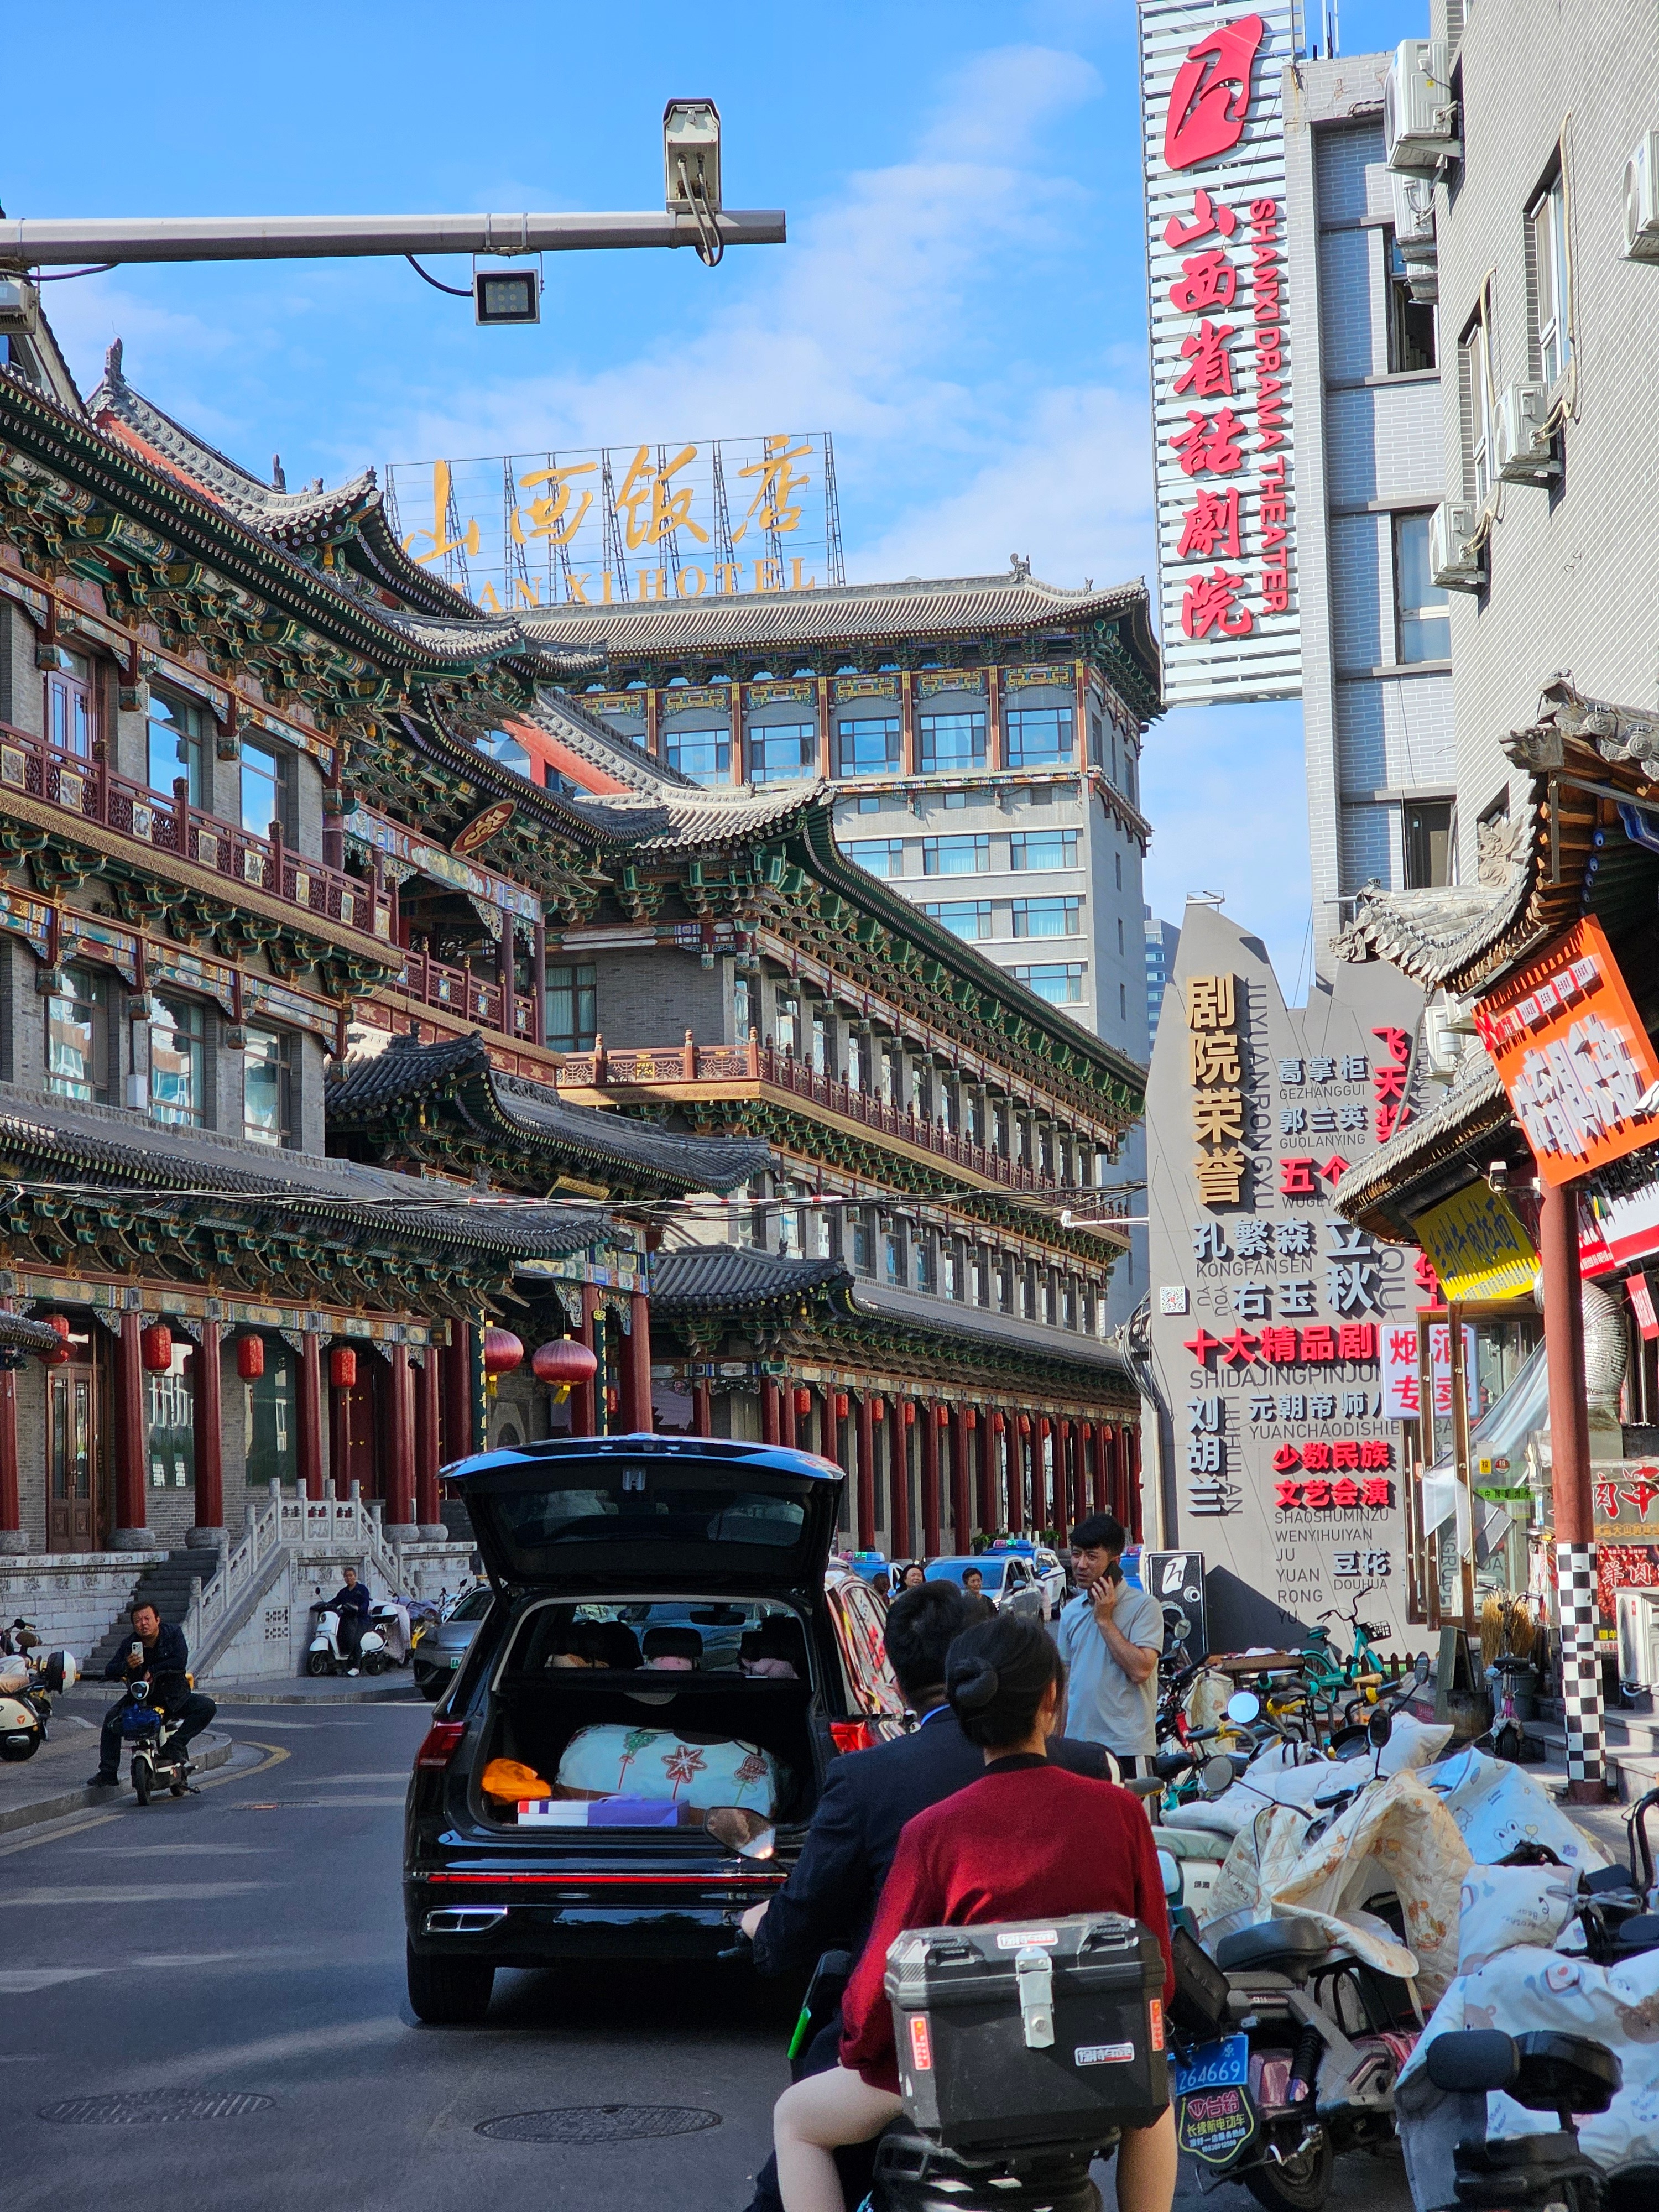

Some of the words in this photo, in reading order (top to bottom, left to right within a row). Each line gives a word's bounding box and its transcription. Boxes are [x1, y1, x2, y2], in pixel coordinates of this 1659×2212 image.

[1249, 199, 1281, 321] SHANXI
[1254, 326, 1284, 451] DRAMA
[1163, 189, 1254, 638] 山西省話劇院
[401, 434, 814, 564] 山西饭店
[1258, 454, 1288, 614] THEATER
[451, 577, 543, 613] AN
[635, 557, 816, 602] HOTEL
[1278, 1055, 1369, 1083] 葛掌柜
[1371, 1026, 1408, 1143] 飞天奖
[1185, 972, 1246, 1204] 剧院荣誉
[1245, 978, 1274, 1209] JUYUANRONGYU
[1279, 1084, 1366, 1100] GEZHANGGUI
[1279, 1104, 1366, 1133] 郭兰英
[1279, 1134, 1366, 1150] GUOLANYING
[1282, 1194, 1335, 1209] WUGEY
[1192, 1217, 1313, 1259] 孔繁森
[1196, 1258, 1313, 1277] KONGFANSEN
[1323, 1217, 1375, 1312] 立秋
[1197, 1286, 1210, 1306] YU
[1214, 1285, 1228, 1317] YOU
[1233, 1278, 1314, 1317] 右玉
[1184, 1322, 1381, 1365] 十大精品剧
[1389, 1329, 1468, 1366] 烟酒
[1391, 1375, 1470, 1412] 专卖
[1186, 1395, 1223, 1514] 刘胡兰
[1223, 1396, 1244, 1515] LIUHULAN
[1272, 1440, 1389, 1470] 少数民族
[1273, 1478, 1389, 1508] 文艺会演
[1274, 1507, 1389, 1525] SHAOSHUMINZU
[1275, 1528, 1373, 1543] WENYIHUIYAN
[1275, 1548, 1295, 1562] JU
[1333, 1548, 1389, 1575] 豆花
[1276, 1568, 1321, 1583] YUAN
[1333, 1578, 1389, 1592] DOUHUA
[1278, 1589, 1323, 1603] RONG
[1279, 1611, 1298, 1624] YU
[1233, 1880, 1249, 1900] Good
[1178, 2060, 1241, 2091] 264669
